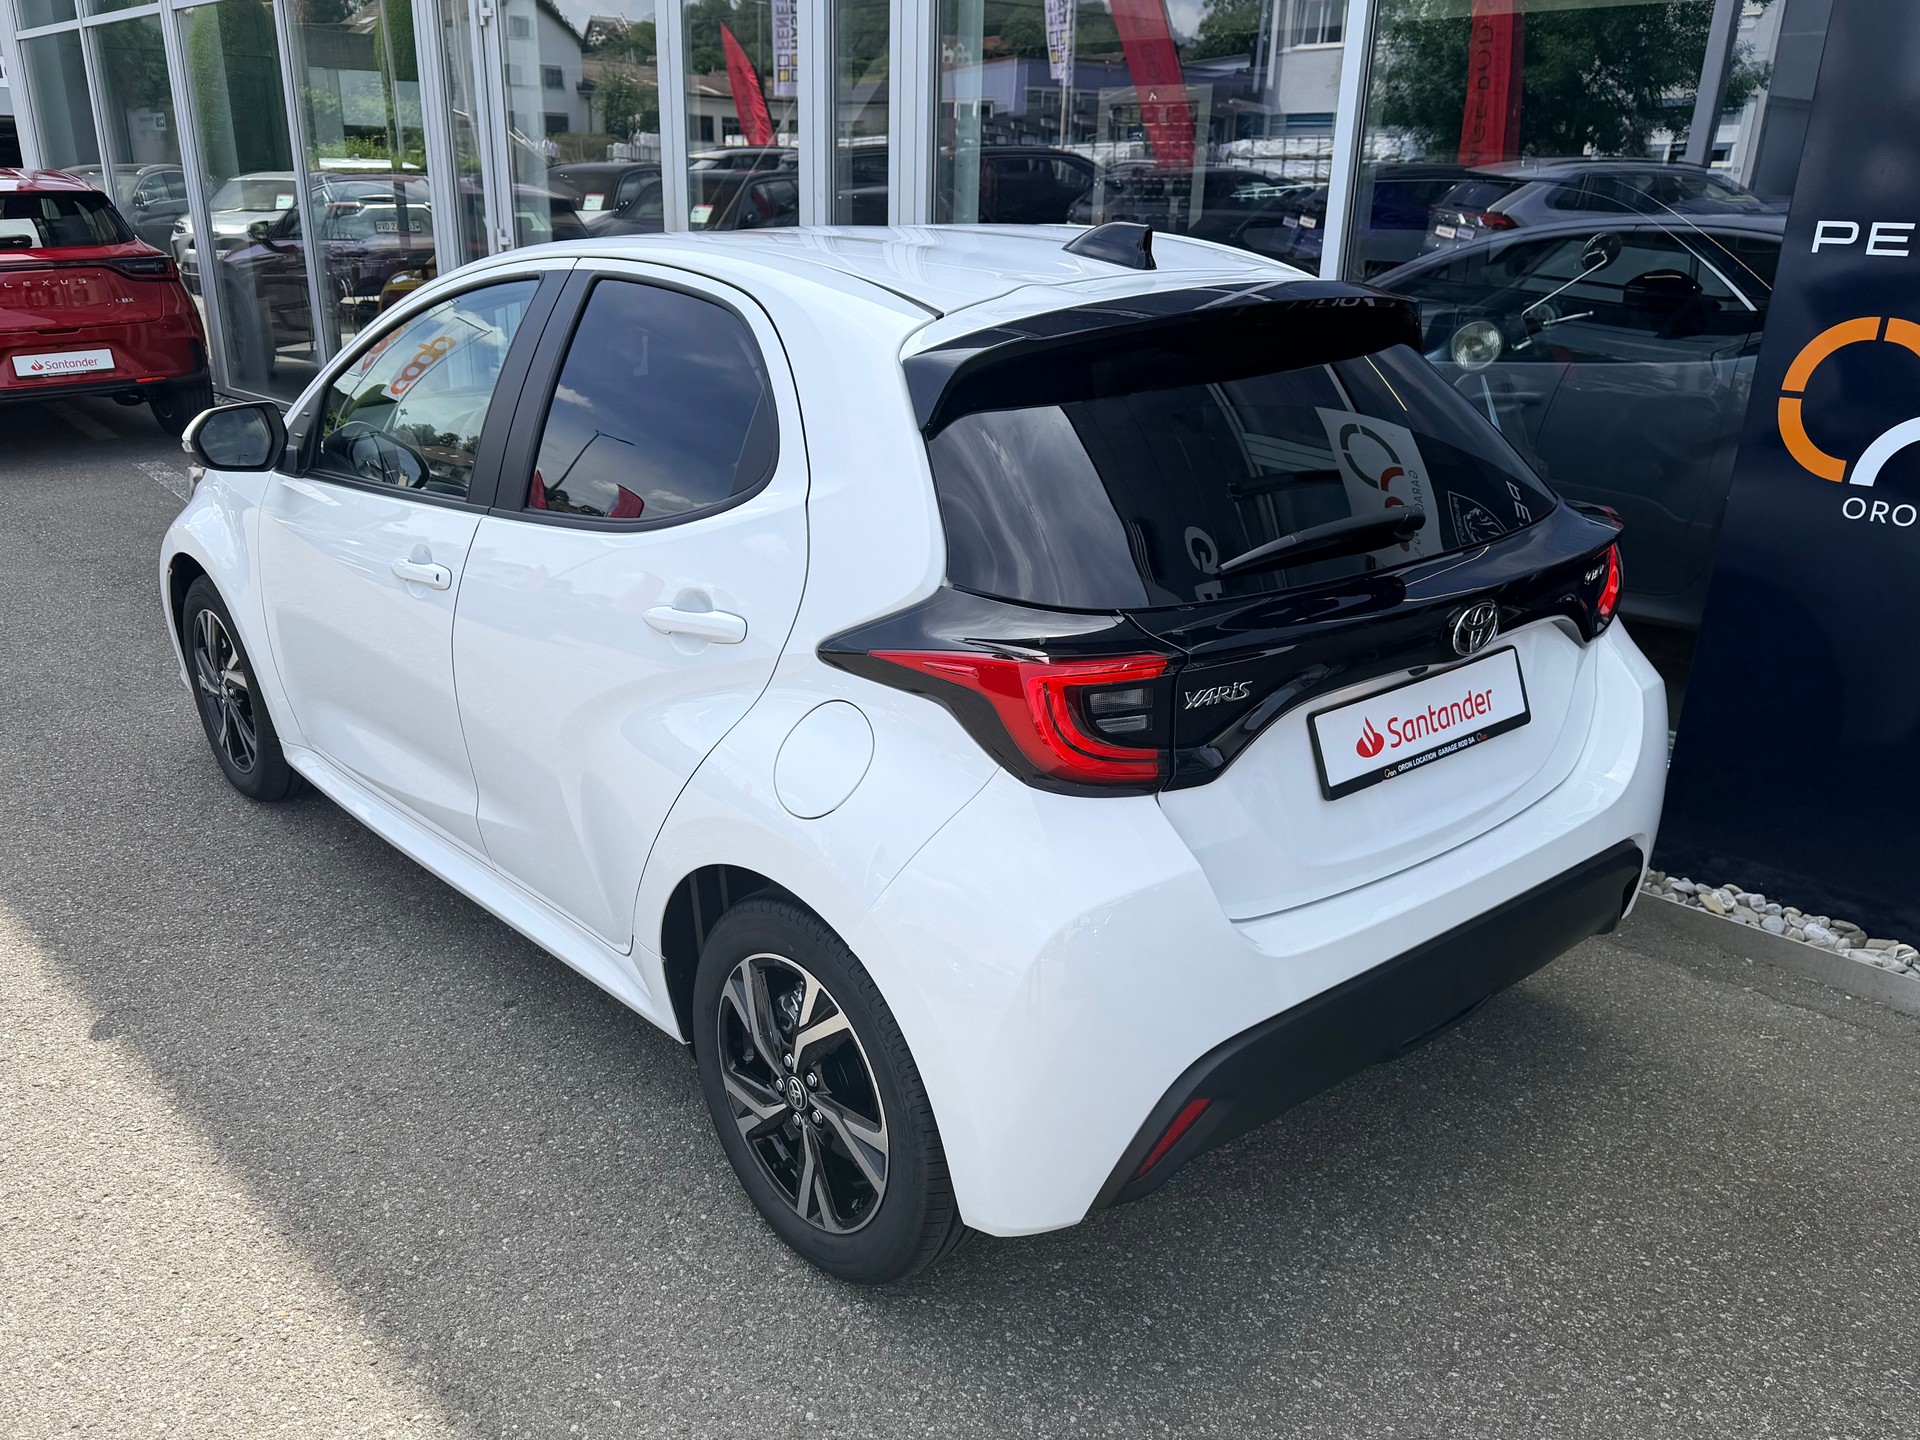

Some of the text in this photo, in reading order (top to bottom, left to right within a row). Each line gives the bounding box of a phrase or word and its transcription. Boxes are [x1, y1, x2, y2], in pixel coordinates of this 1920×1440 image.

[1811, 220, 1916, 257] PE
[3, 278, 87, 288] LEXUS
[44, 358, 98, 370] Santander
[1842, 497, 1916, 527] ORO
[1387, 689, 1492, 748] Santander
[1398, 761, 1413, 772] ORON
[1412, 752, 1437, 766] LOCATION
[1438, 743, 1458, 756] GARAGE
[1468, 736, 1476, 745] SA
